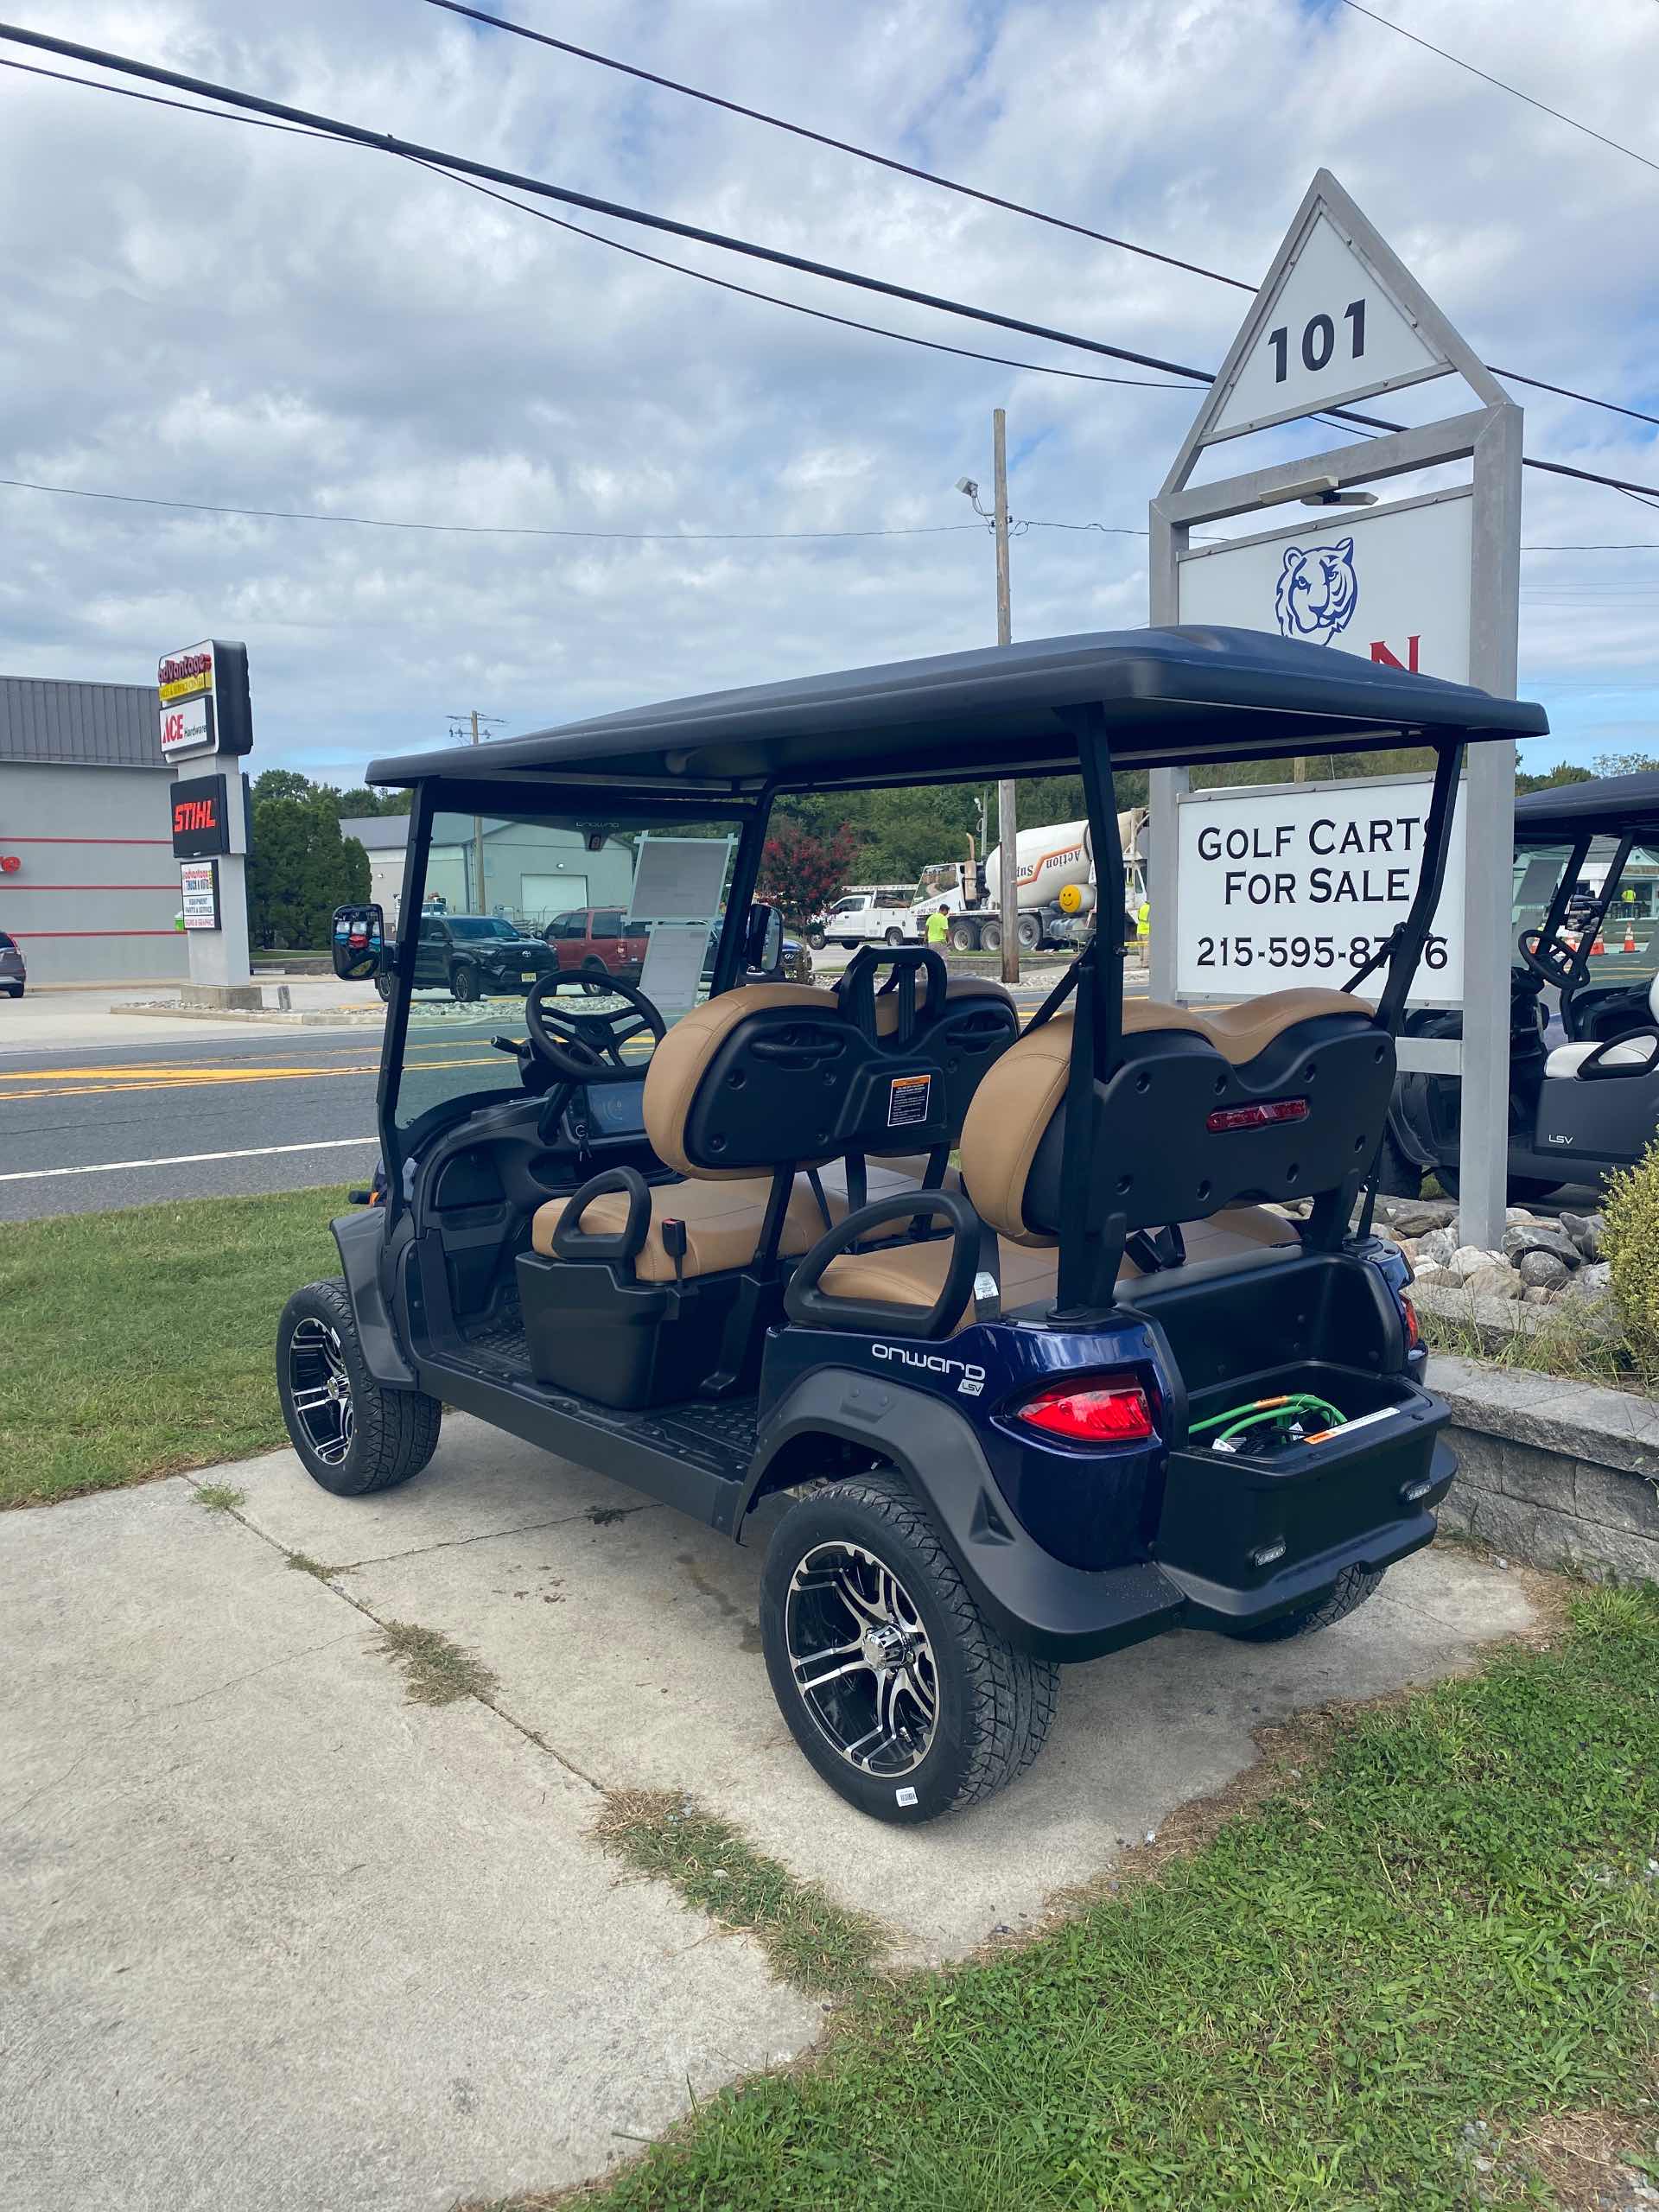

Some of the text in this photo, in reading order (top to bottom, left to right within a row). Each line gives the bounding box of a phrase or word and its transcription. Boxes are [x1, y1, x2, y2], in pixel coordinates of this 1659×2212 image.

[1268, 298, 1366, 384] 101
[162, 714, 183, 743] ACE
[184, 725, 207, 737] Hardware
[174, 800, 216, 832] STIHL
[1198, 817, 1431, 861] GOLF CART
[1046, 849, 1081, 868] Action
[1224, 868, 1410, 906] FOR SALE
[1197, 936, 1449, 969] 215-595-876
[1548, 1134, 1573, 1144] LSV
[962, 1383, 982, 1393] LSV
